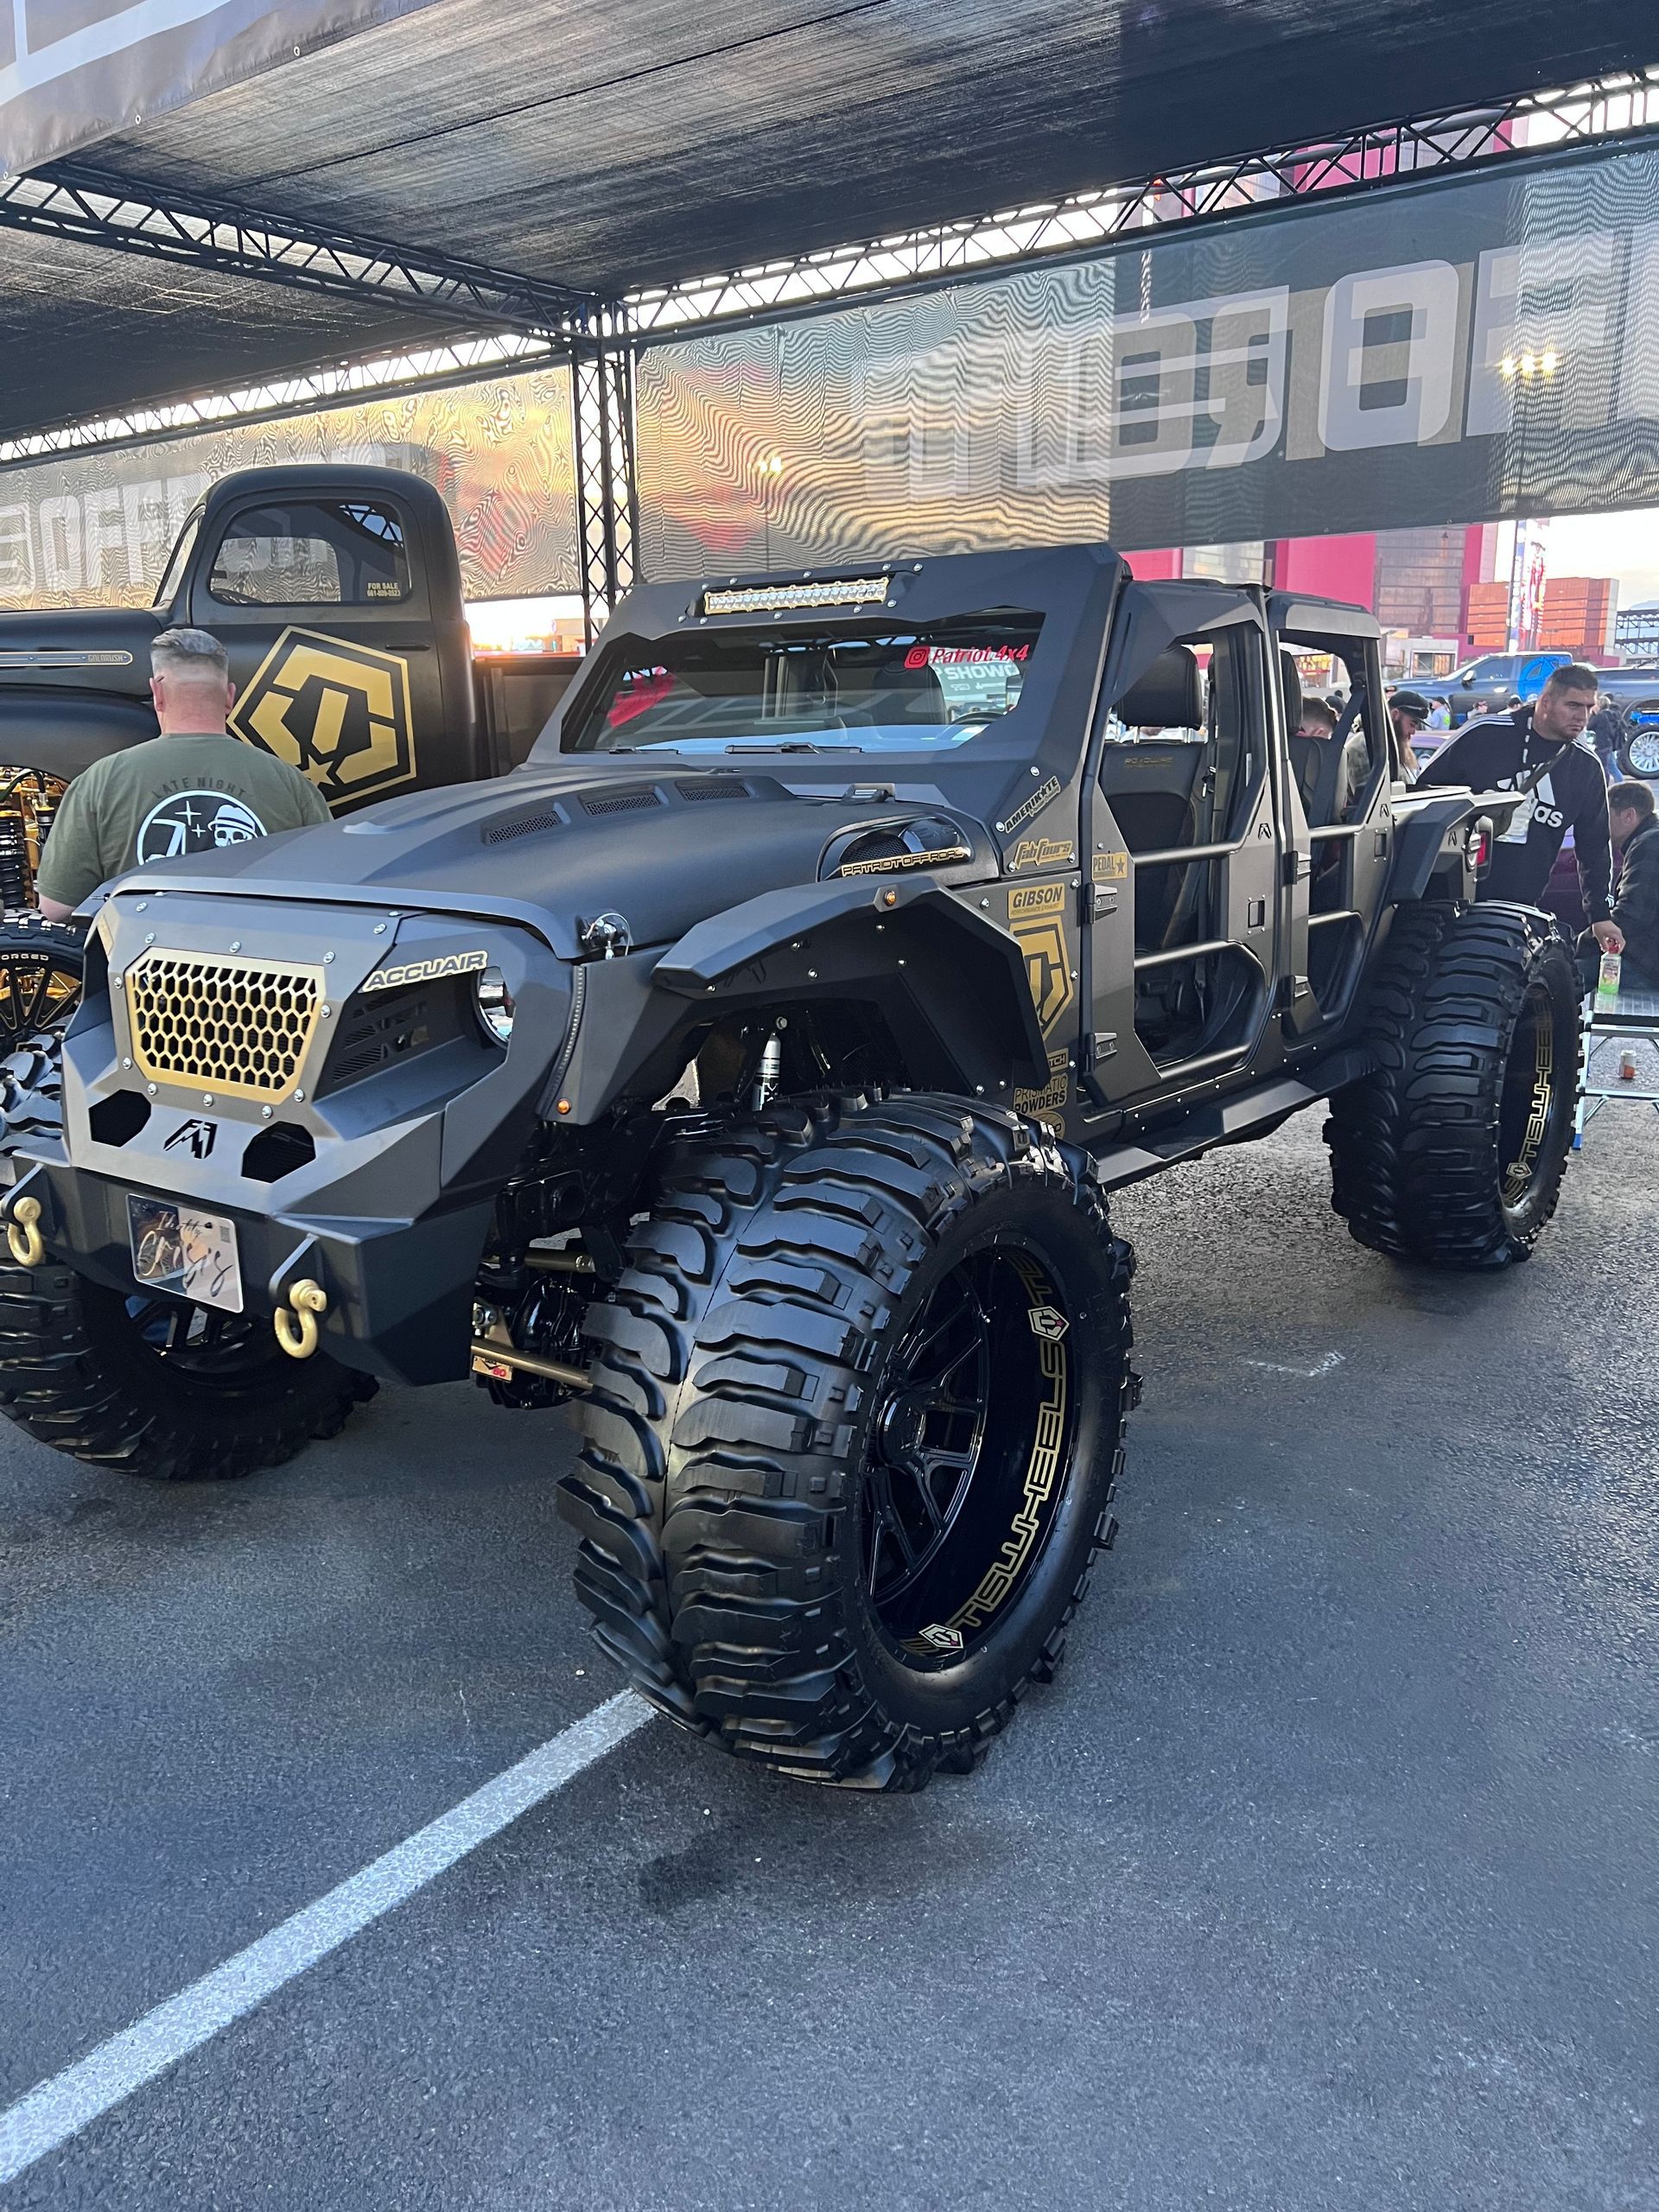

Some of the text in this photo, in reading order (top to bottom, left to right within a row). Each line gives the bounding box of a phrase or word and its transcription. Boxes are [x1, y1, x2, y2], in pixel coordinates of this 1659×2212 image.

[367, 582, 399, 590] FOR SALE
[151, 777, 246, 799] LATE NIGHT
[1093, 856, 1116, 872] PEDAL
[1013, 887, 1063, 908] GIBSON
[365, 952, 486, 989] ACCUAIR
